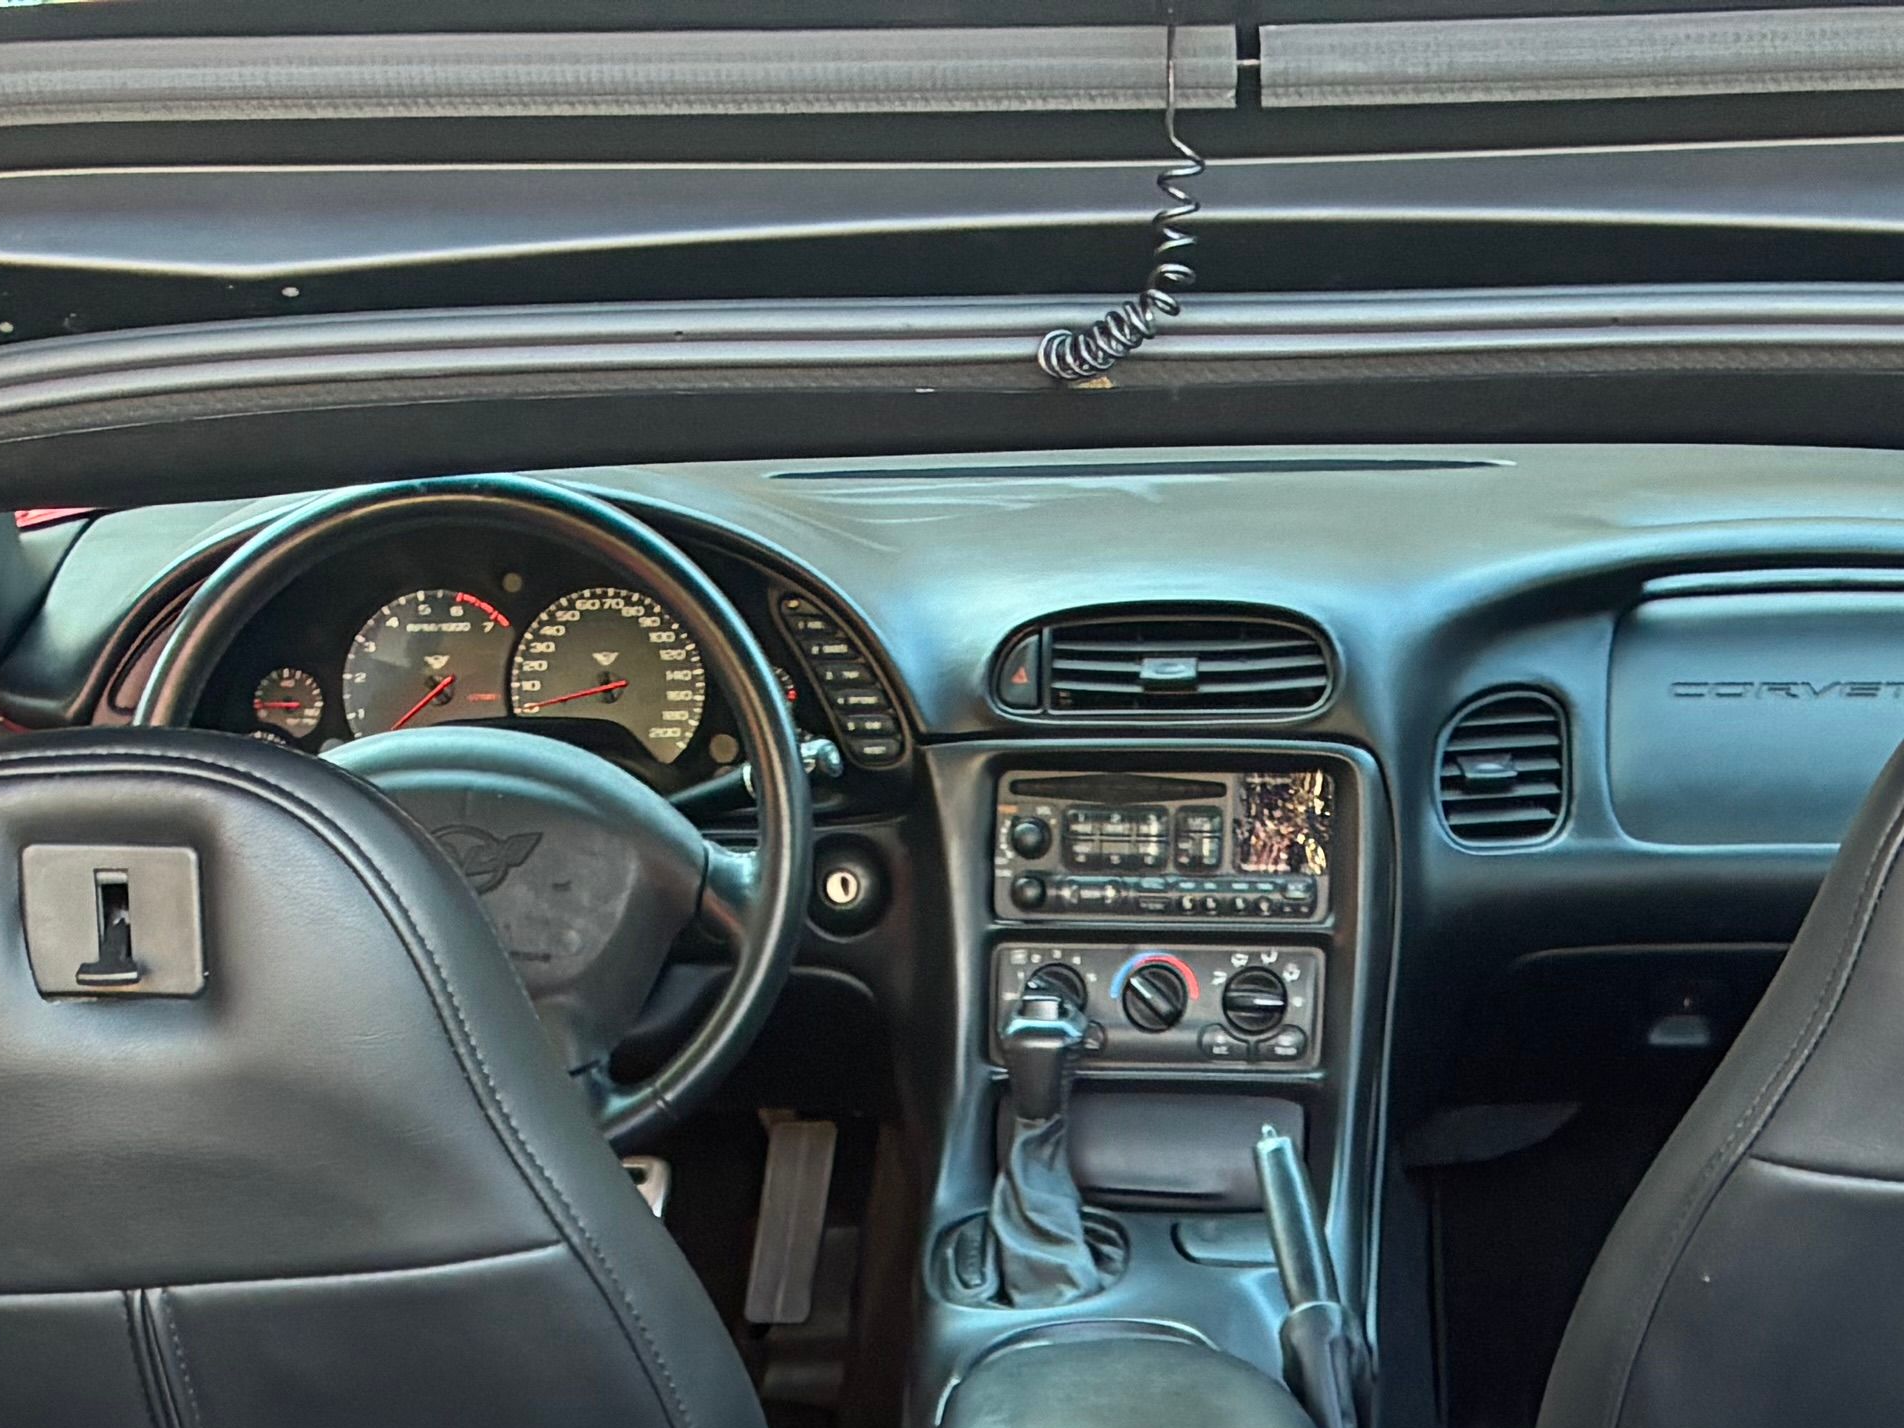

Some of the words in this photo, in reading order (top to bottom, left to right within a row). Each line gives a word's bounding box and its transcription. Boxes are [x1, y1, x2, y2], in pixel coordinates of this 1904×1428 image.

[575, 598, 600, 610] 60
[602, 598, 624, 610] 70
[539, 625, 566, 636] 40
[529, 641, 556, 653] 30
[354, 672, 367, 683] 2
[521, 680, 541, 691] 10
